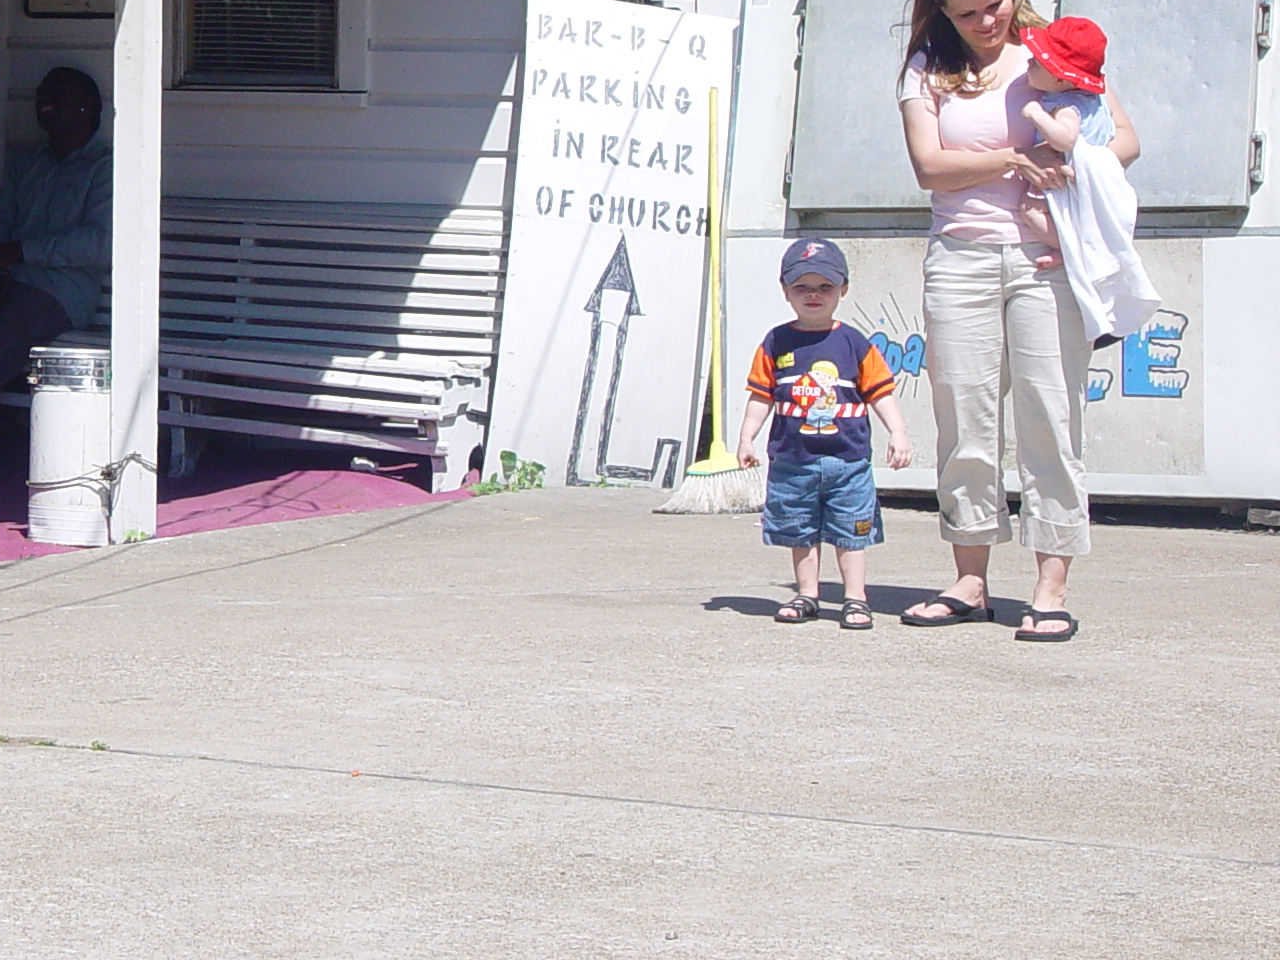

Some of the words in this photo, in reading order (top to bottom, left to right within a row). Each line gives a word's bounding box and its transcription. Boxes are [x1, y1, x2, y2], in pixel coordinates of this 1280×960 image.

[600, 133, 694, 175] REAR
[535, 185, 575, 218] OF
[588, 192, 712, 238] CHURCH
[792, 384, 822, 398] DETOUR
